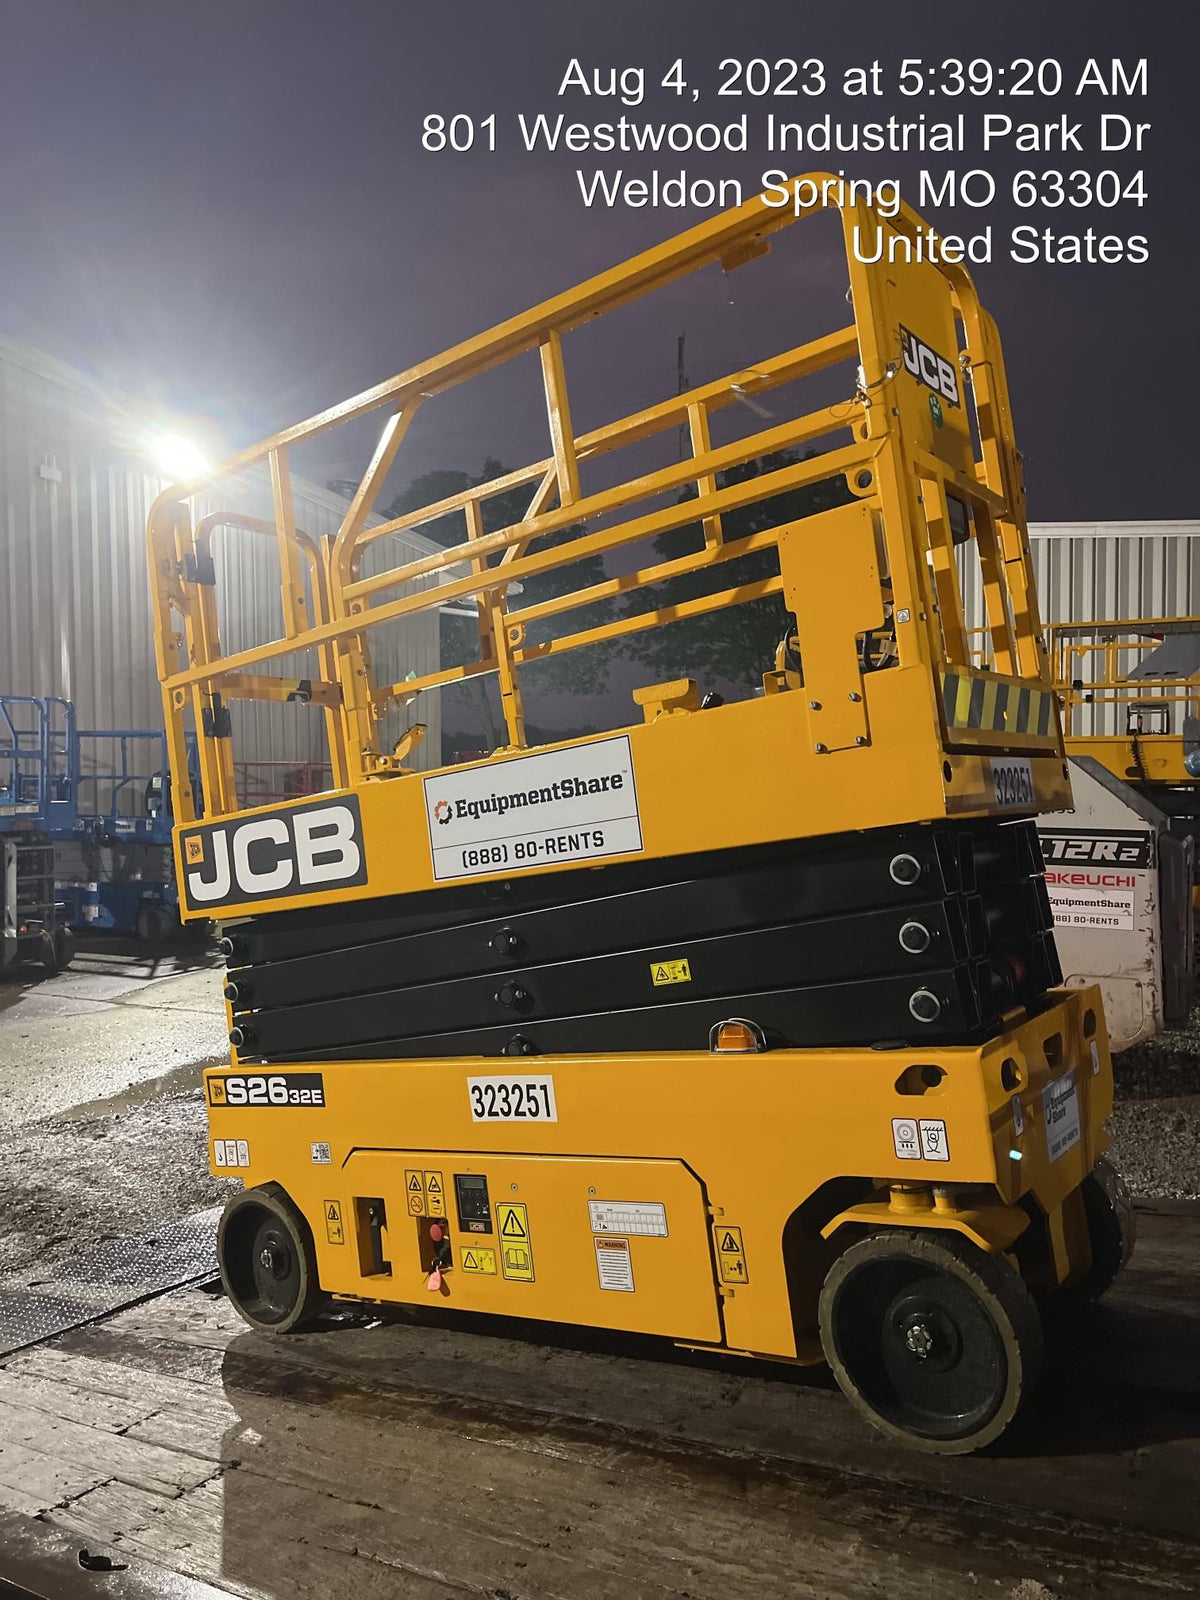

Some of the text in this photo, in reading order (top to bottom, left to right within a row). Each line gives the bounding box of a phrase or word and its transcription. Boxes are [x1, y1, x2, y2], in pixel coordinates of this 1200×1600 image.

[904, 336, 958, 402] JCB
[455, 774, 624, 819] EquipmentShare
[994, 767, 1033, 804] 323251
[188, 806, 360, 901] JCB
[462, 830, 604, 868] (888) 80-RENTS
[1040, 840, 1140, 861] 12R2
[471, 1083, 551, 1118] 323251
